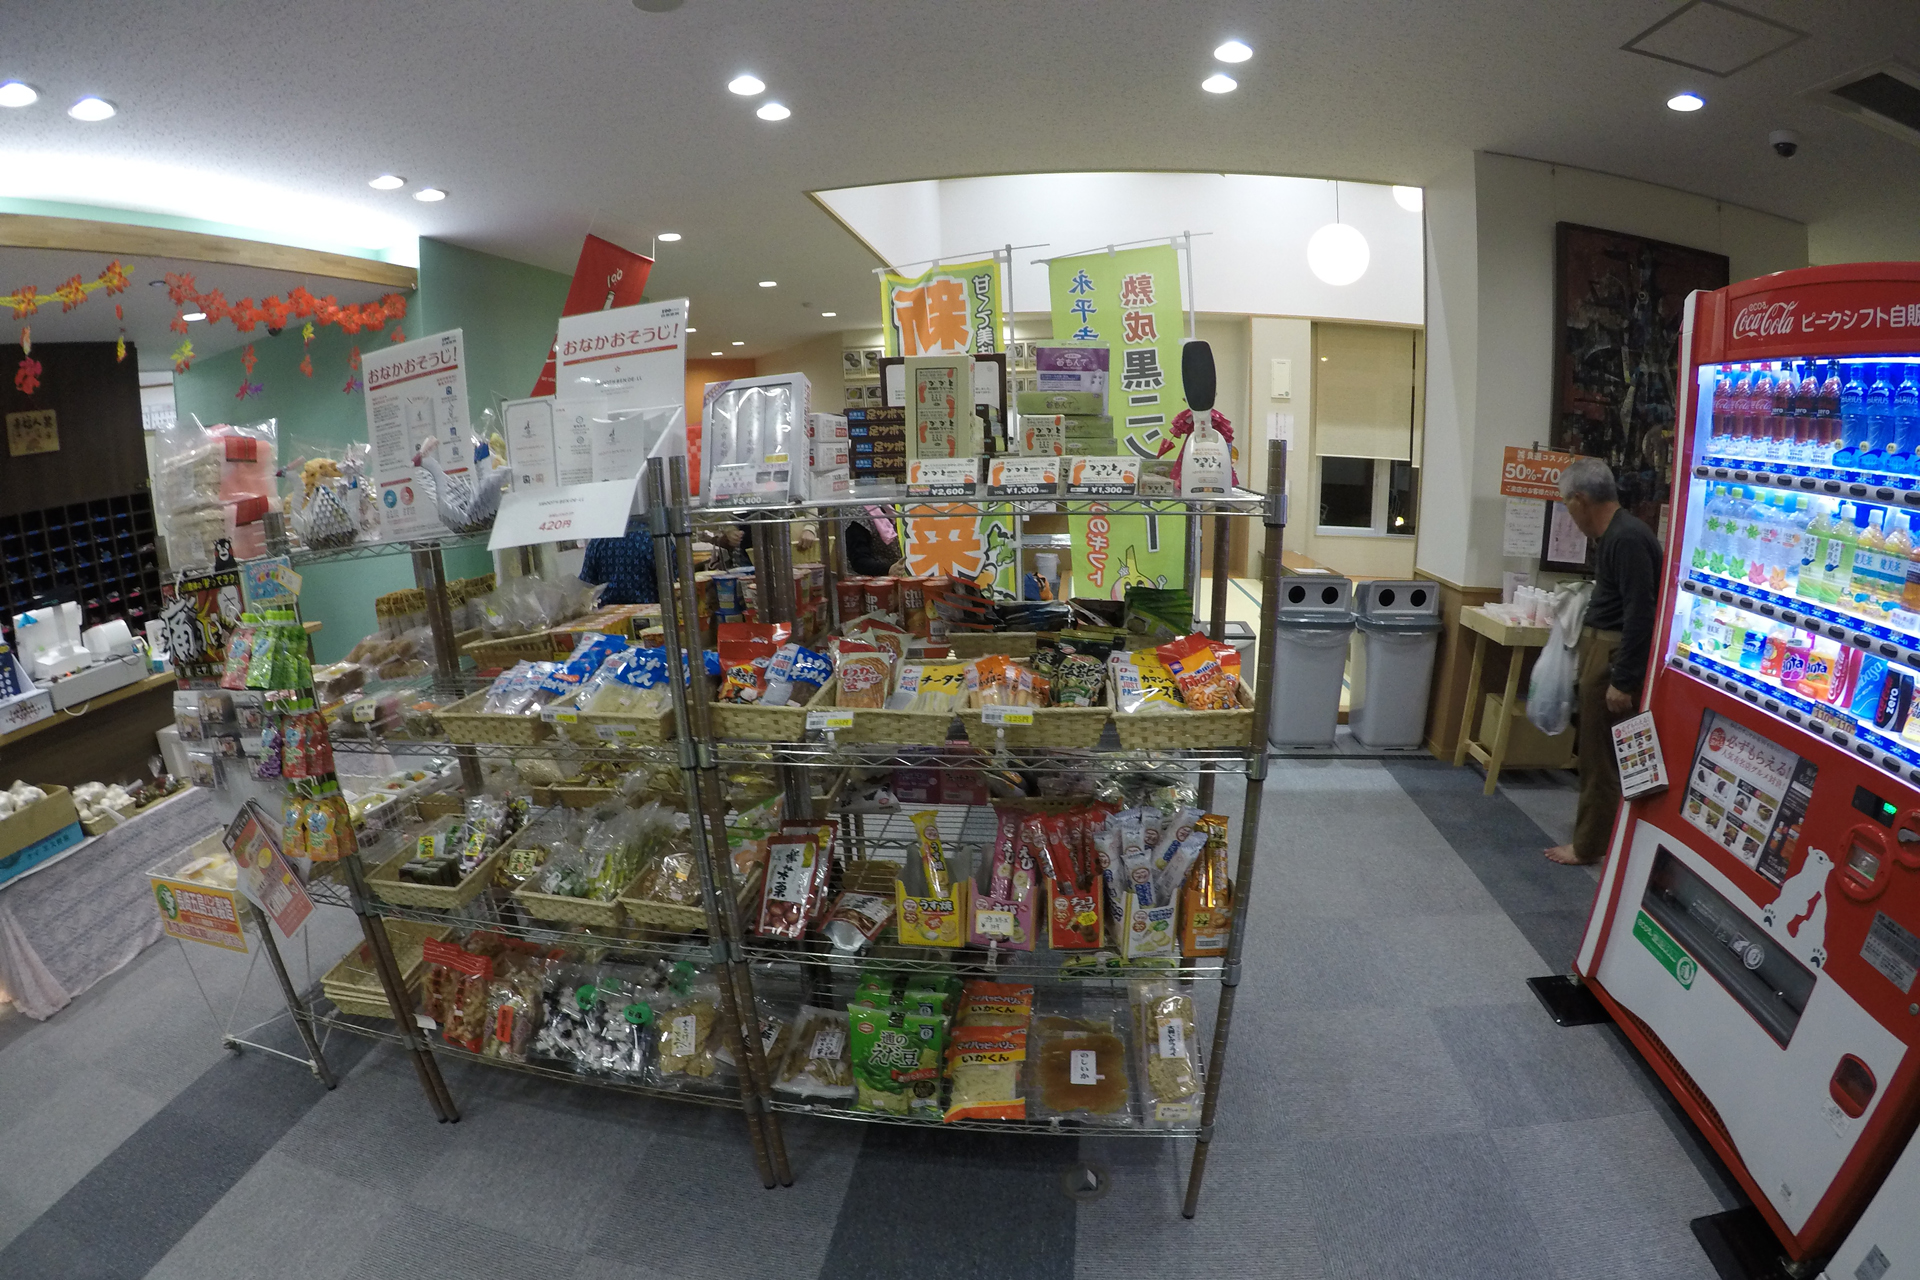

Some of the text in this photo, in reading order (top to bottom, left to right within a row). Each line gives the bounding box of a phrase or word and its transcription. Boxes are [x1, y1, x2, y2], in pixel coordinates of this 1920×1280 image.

[1733, 301, 1799, 339] Coca-Cola
[931, 488, 964, 496] ¥2,600
[539, 519, 572, 531] 420円
[905, 600, 923, 609] sta
[1886, 688, 1899, 714] zero
[920, 899, 956, 912] うす焼
[880, 1031, 908, 1046] 通の
[869, 1042, 920, 1068] えだ豆
[961, 1053, 1010, 1063] いかくん
